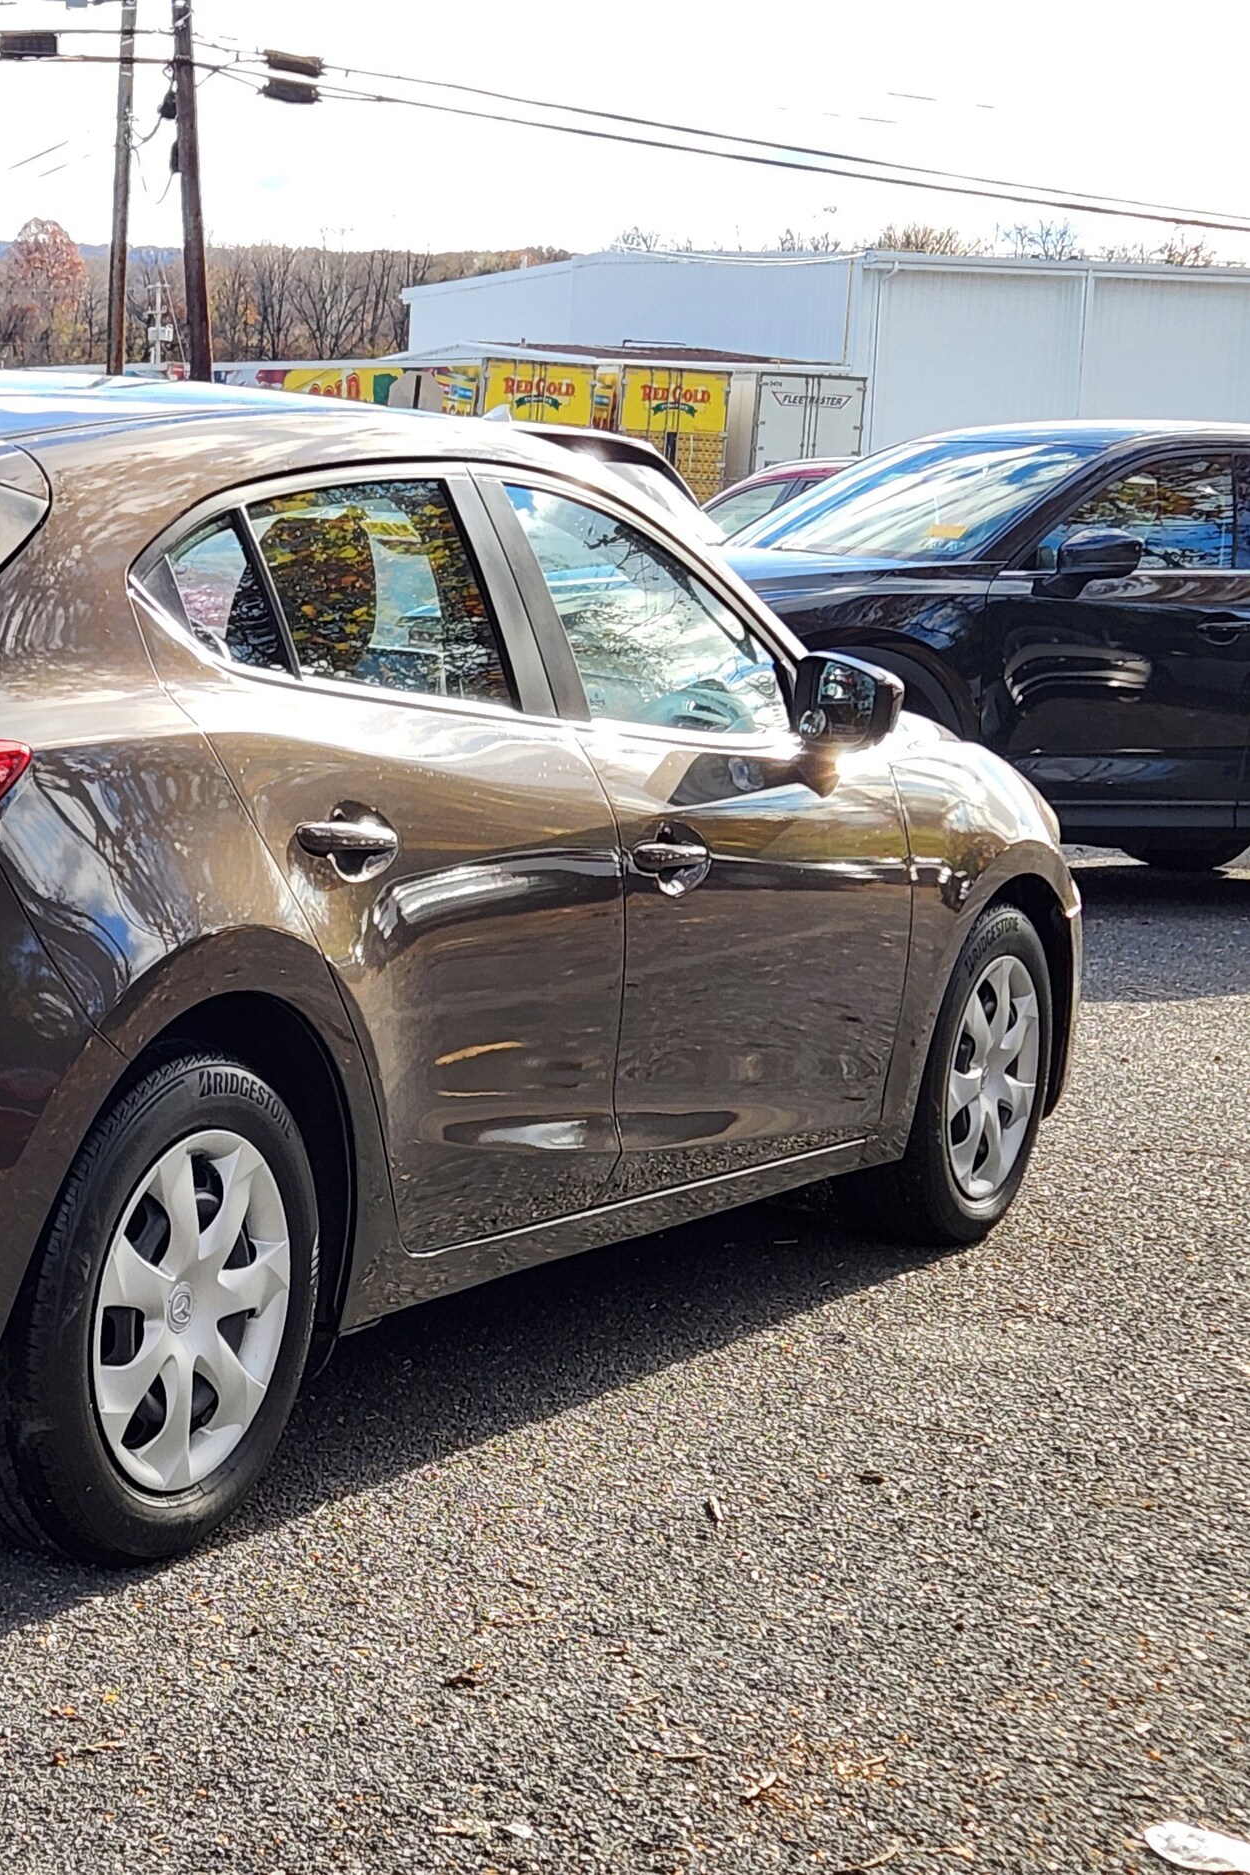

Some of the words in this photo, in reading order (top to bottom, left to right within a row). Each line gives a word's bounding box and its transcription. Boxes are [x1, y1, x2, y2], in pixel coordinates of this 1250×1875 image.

[503, 375, 533, 395] RED
[535, 377, 576, 397] GOLD
[640, 384, 670, 402] RED
[672, 385, 711, 403] GOLD
[198, 1069, 297, 1140] BRIDGESTONE
